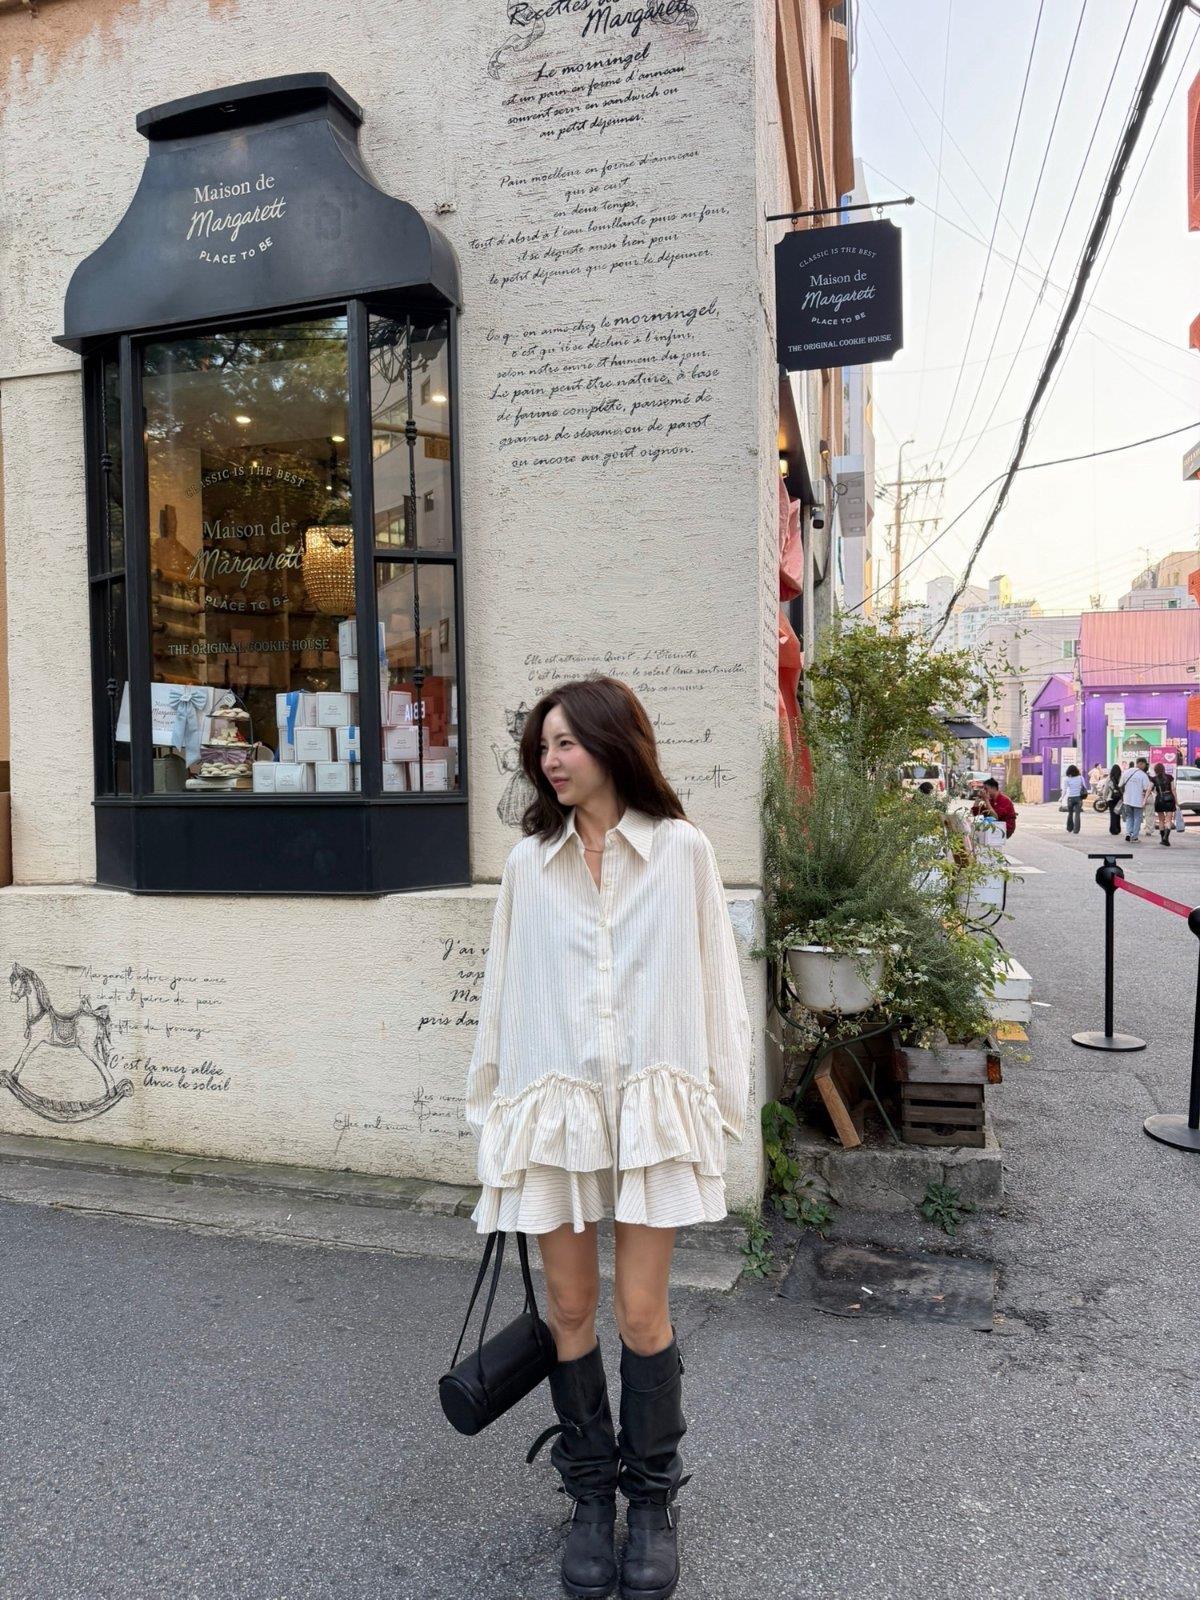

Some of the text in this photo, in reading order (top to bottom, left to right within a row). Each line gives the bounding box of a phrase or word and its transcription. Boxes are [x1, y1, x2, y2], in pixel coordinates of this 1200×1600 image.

[533, 42, 652, 82] Le morningel
[572, 85, 585, 94] en
[587, 78, 621, 96] forme
[507, 107, 554, 124] souvent
[585, 102, 599, 111] en
[602, 86, 660, 108] sandwich
[556, 119, 589, 140] petit
[500, 175, 527, 188] Pain
[584, 167, 599, 175] en
[600, 159, 636, 178] forme
[193, 173, 275, 203] Maison de
[186, 196, 287, 242] Margarett
[199, 236, 274, 264] PLACE TO BE
[799, 249, 829, 268] CLASSIC
[841, 246, 857, 254] THE
[858, 248, 877, 258] BEST
[810, 269, 868, 287] Maison de
[801, 285, 876, 313] Margarett
[811, 316, 838, 325] PLACE
[855, 312, 866, 321] BE
[787, 333, 892, 353] THE ORIGINAL COOKIE HOUSE
[185, 464, 305, 499] CLASSIC IS THE BEST
[203, 515, 291, 540] Maison de
[189, 546, 304, 589] Margarett
[205, 595, 246, 612] PLACE
[250, 601, 267, 612] TO
[168, 644, 189, 655] THE
[192, 641, 246, 655] ORIGINAL
[292, 638, 330, 651] HOUSE
[442, 938, 475, 961] J'ai
[417, 1012, 453, 1031] pris
